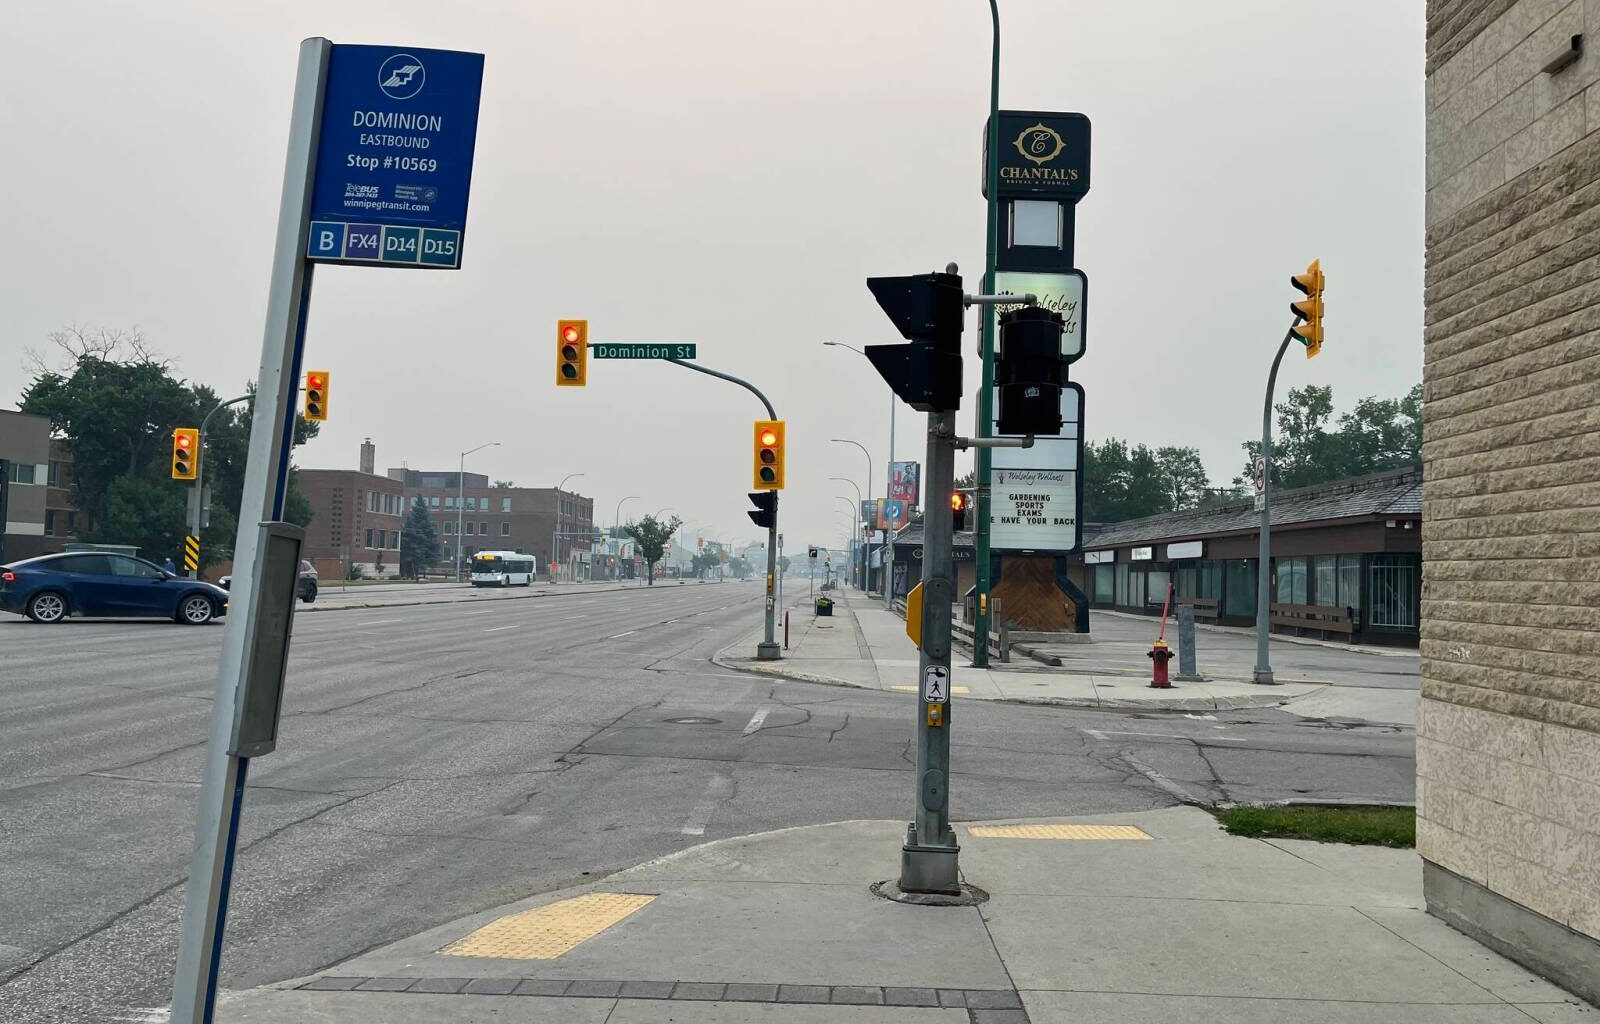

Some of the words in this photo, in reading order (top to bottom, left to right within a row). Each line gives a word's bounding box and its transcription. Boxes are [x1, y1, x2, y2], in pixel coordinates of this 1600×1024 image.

[353, 110, 442, 132] DOMINION
[360, 133, 430, 149] EASTBOUND
[347, 154, 379, 171] Stop
[383, 156, 437, 172] #10569
[1000, 166, 1079, 180] CHANTAL'S
[343, 199, 430, 212] winnipegtransit.com
[319, 231, 334, 251] B
[349, 233, 378, 249] FX4
[386, 236, 416, 252] D14
[424, 239, 454, 255] D15
[599, 345, 669, 358] Dominion
[676, 346, 691, 358] St
[1008, 493, 1051, 502] GARDENING
[1015, 501, 1044, 509] SPORTS
[1017, 509, 1042, 517] EXAMS
[1001, 516, 1021, 524] HAVE
[1026, 517, 1047, 525] YOUR
[1053, 518, 1075, 526] BACK
